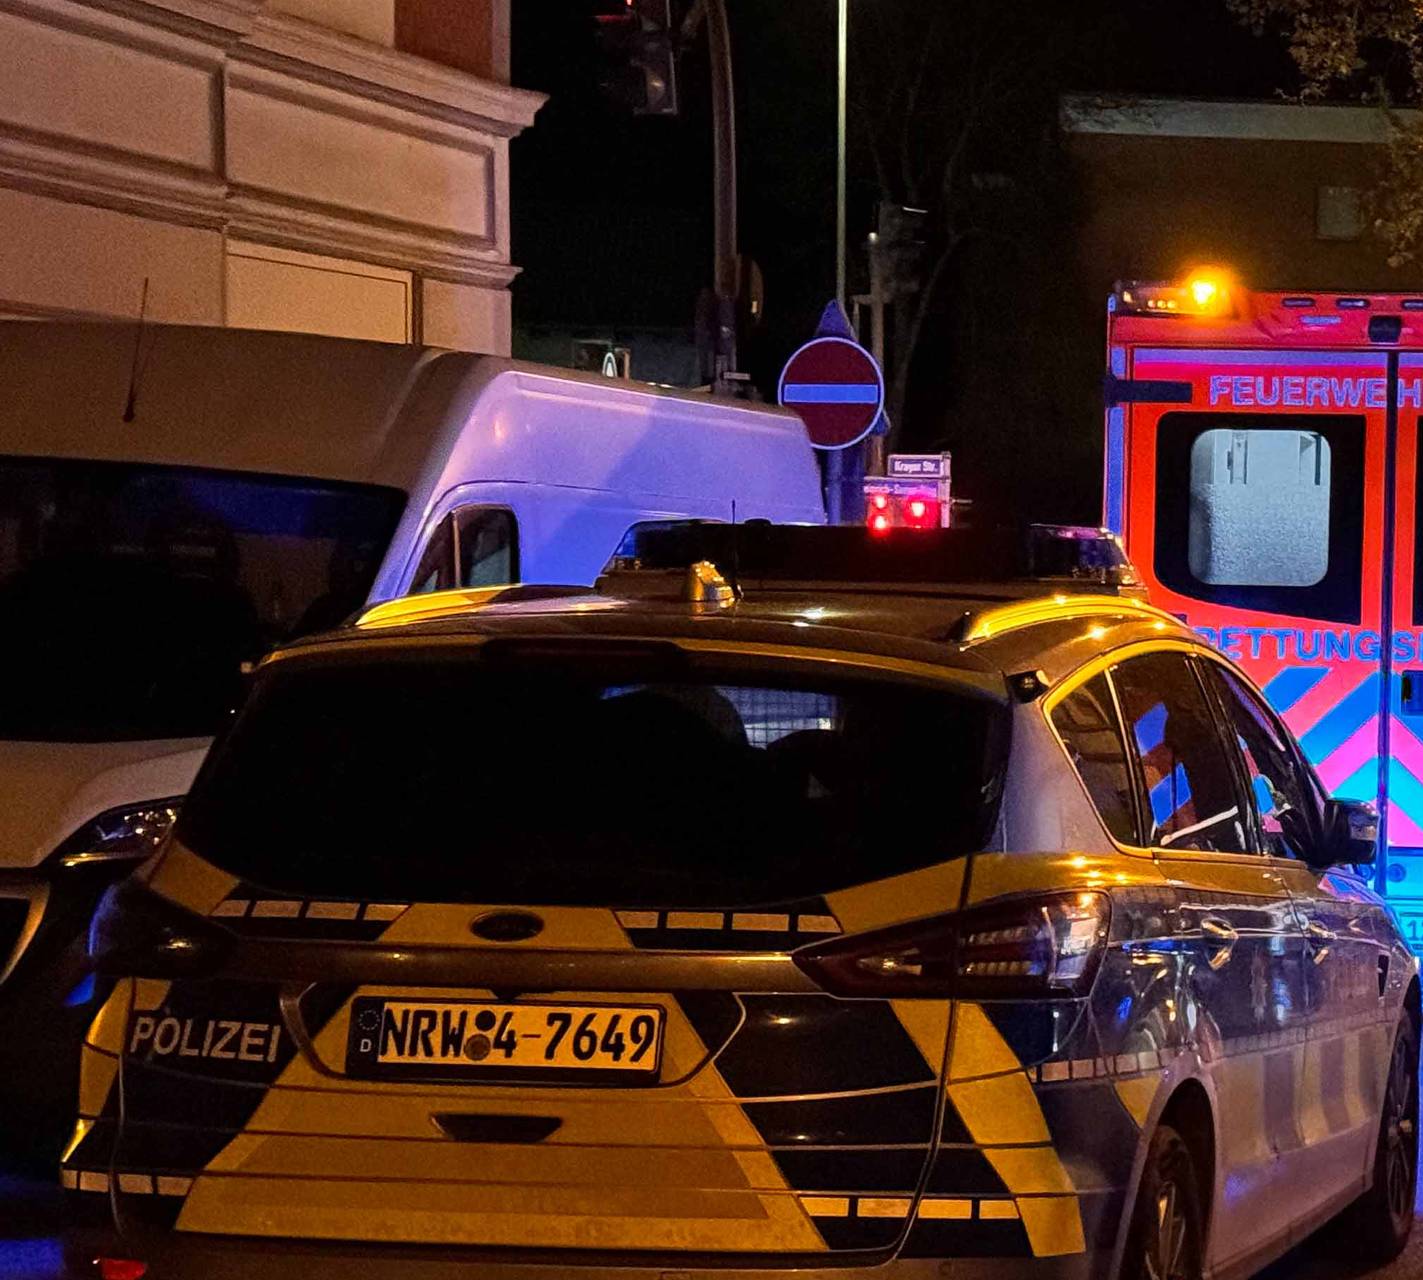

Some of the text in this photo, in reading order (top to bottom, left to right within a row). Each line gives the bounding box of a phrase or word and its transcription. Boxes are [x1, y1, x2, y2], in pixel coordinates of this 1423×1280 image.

[129, 1016, 282, 1064] POLIZEI
[360, 1038, 372, 1052] D
[379, 1008, 656, 1063] NRW 4-7649
